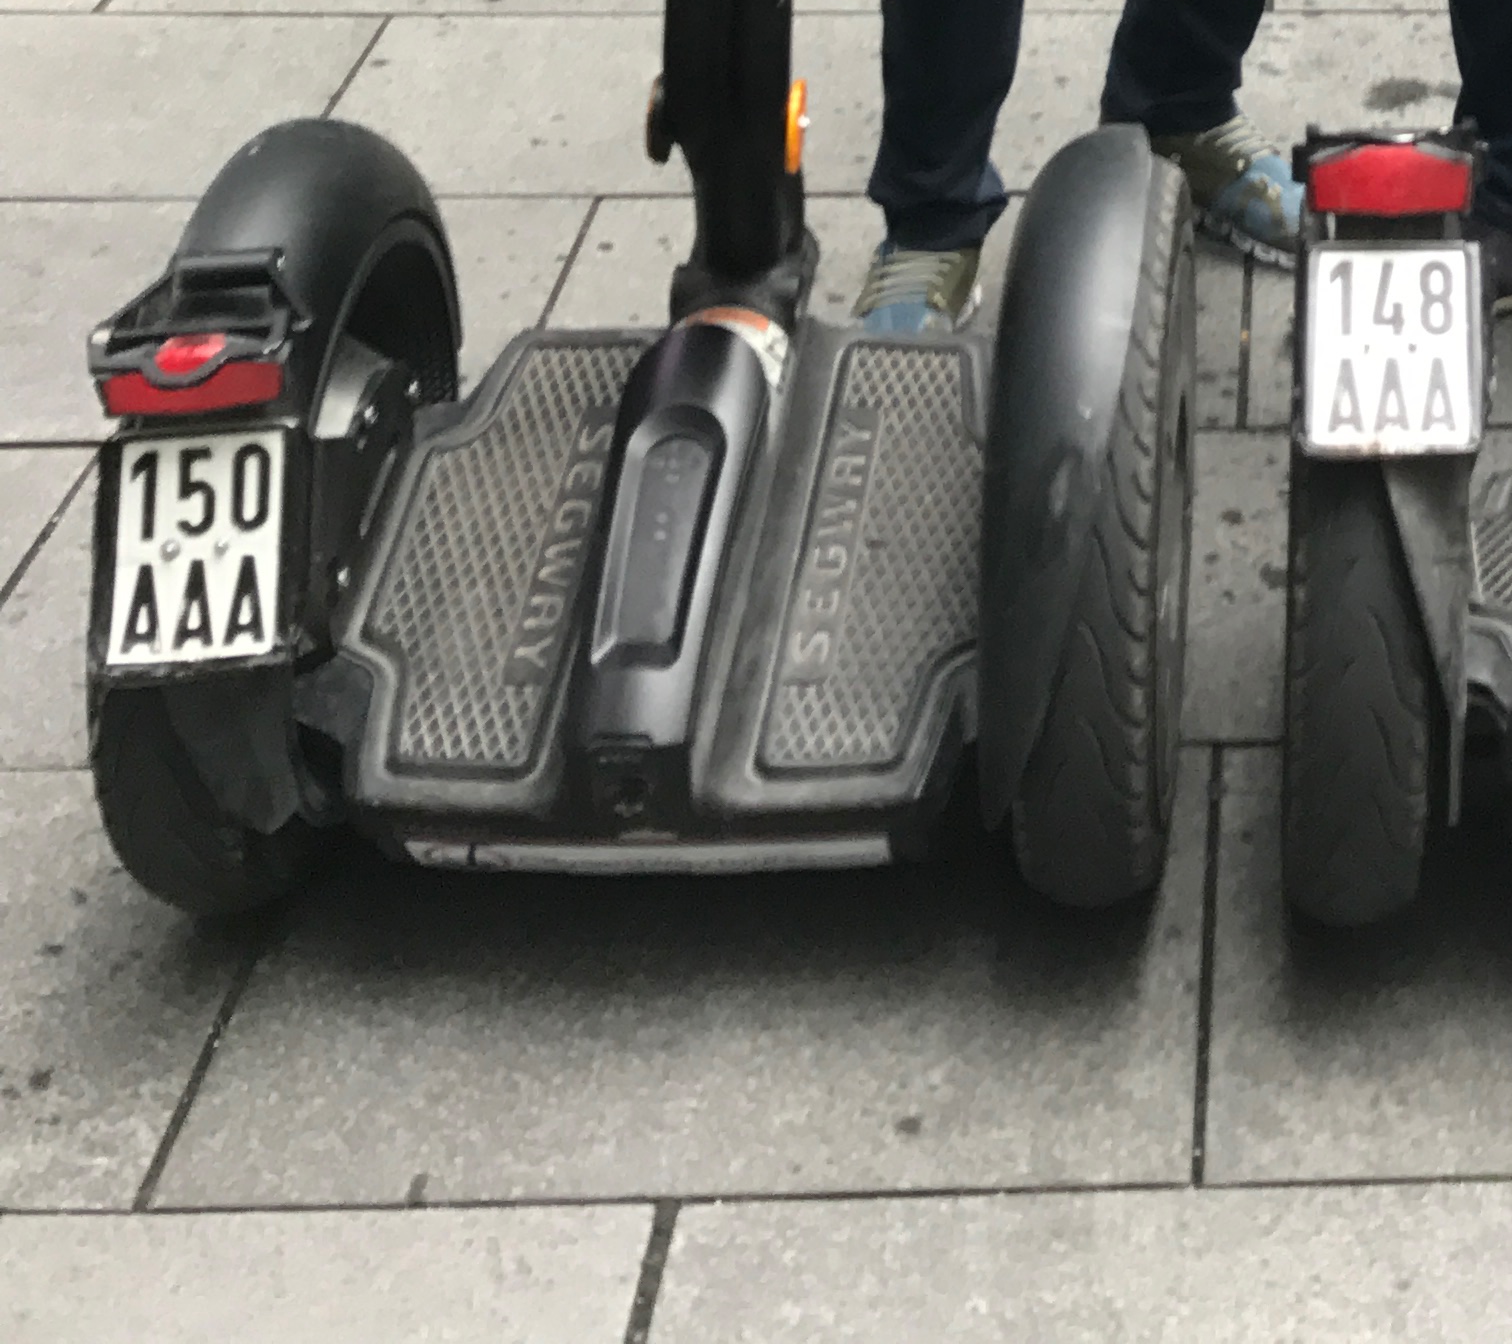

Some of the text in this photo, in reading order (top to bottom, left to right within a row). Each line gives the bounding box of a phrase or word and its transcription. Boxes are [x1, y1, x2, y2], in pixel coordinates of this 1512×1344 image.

[1329, 260, 1455, 336] 148
[1328, 357, 1456, 433] AAA
[130, 443, 272, 541] 150
[514, 423, 615, 666] SEGWAY
[790, 420, 872, 664] SEGWAY
[120, 555, 266, 655] AAA
